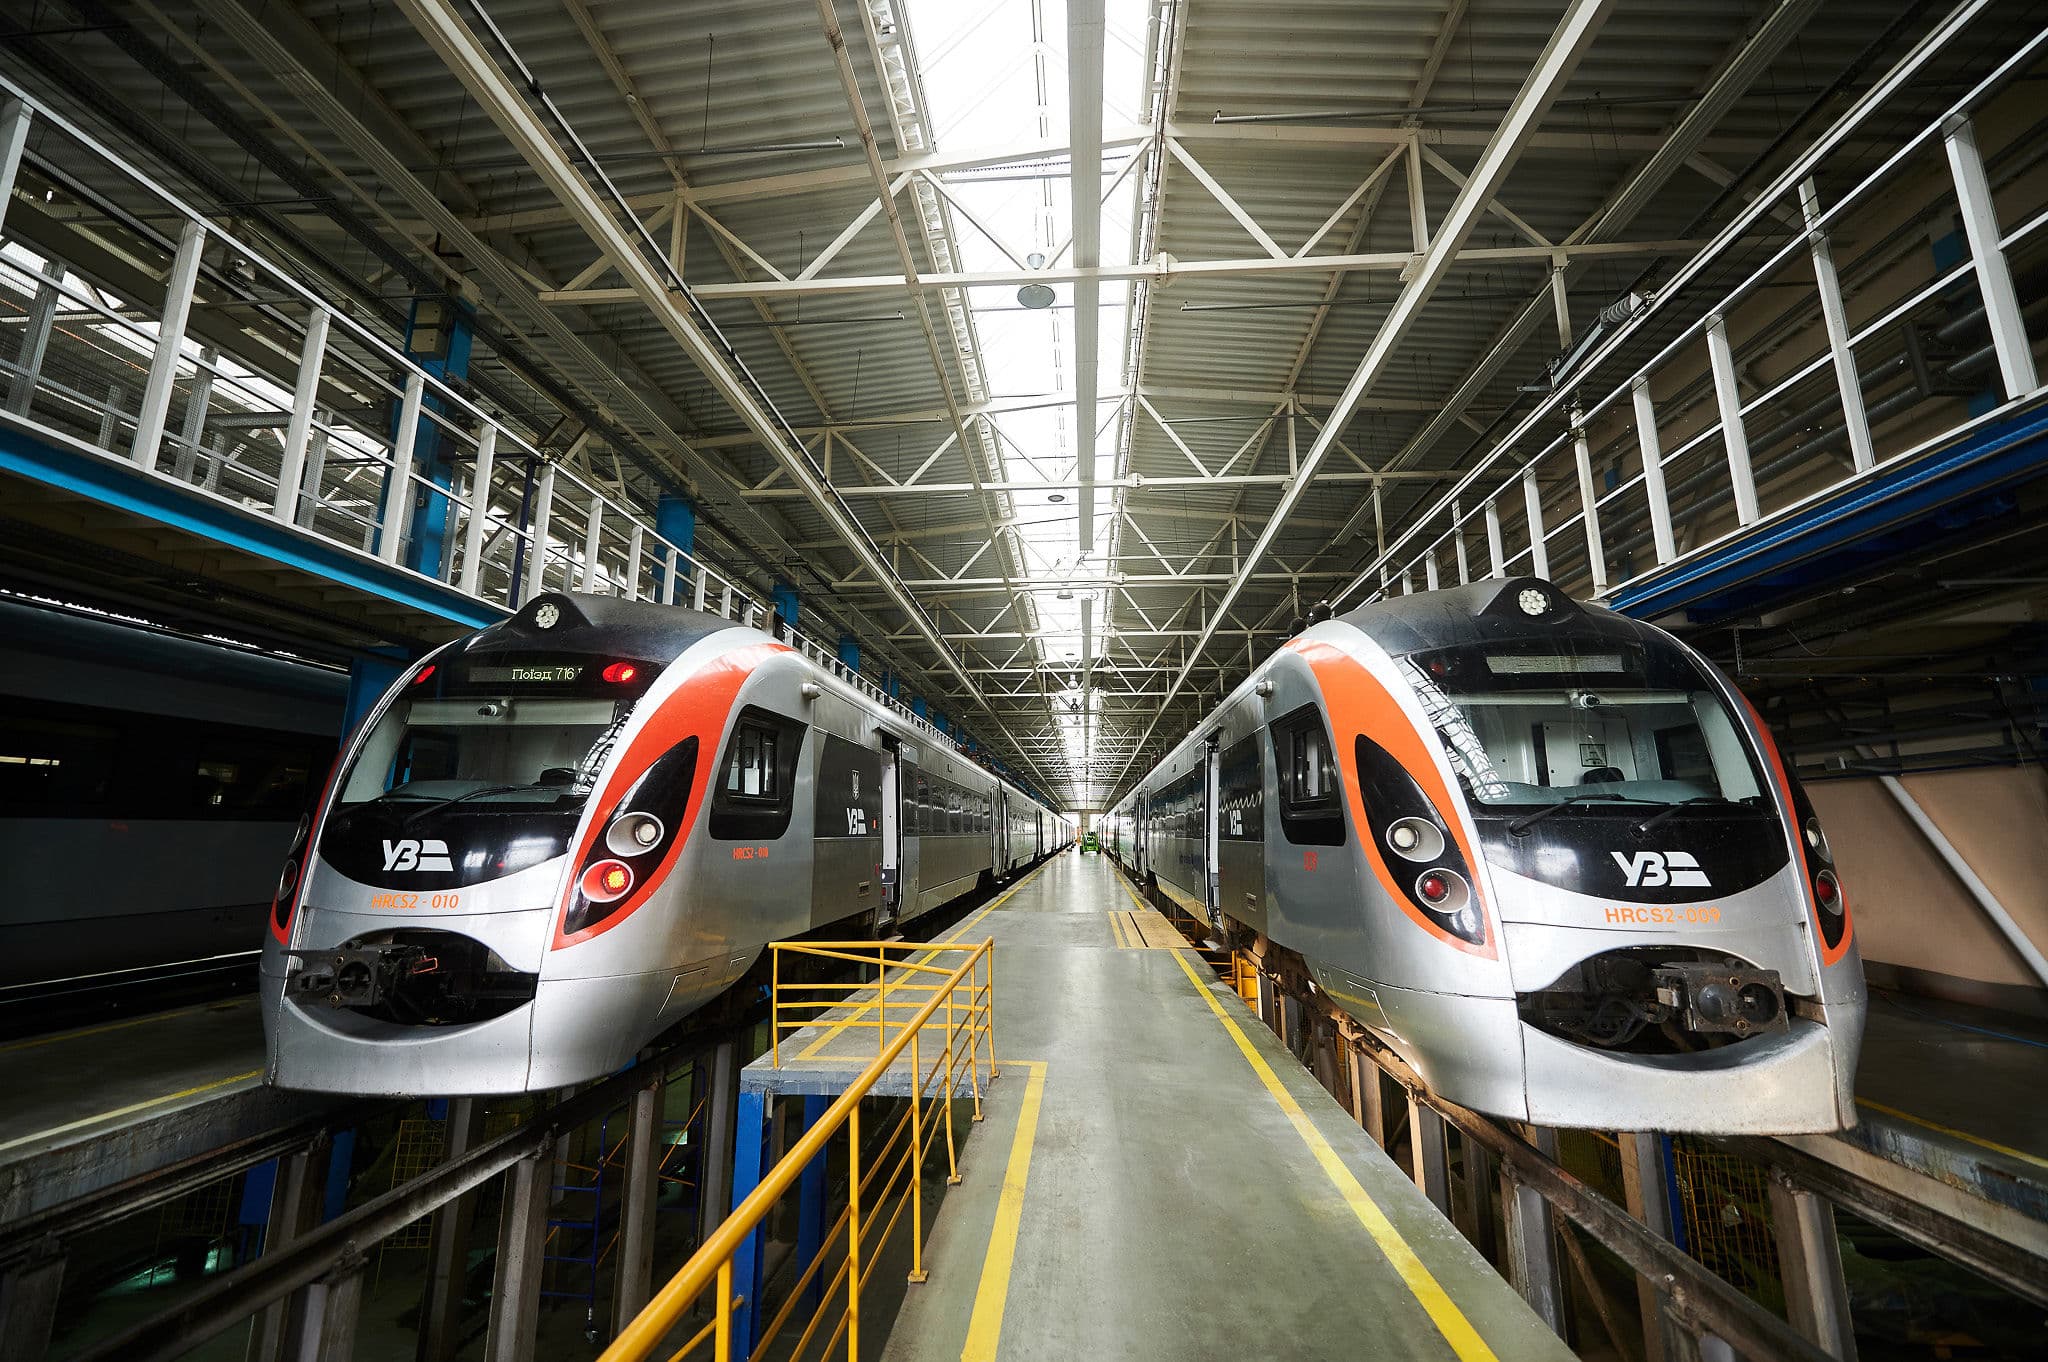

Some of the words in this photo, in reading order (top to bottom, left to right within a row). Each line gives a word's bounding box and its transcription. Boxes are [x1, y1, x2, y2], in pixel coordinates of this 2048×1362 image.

[512, 668, 552, 681] Поїзд
[371, 893, 419, 909] HRCS2
[431, 894, 460, 909] 010
